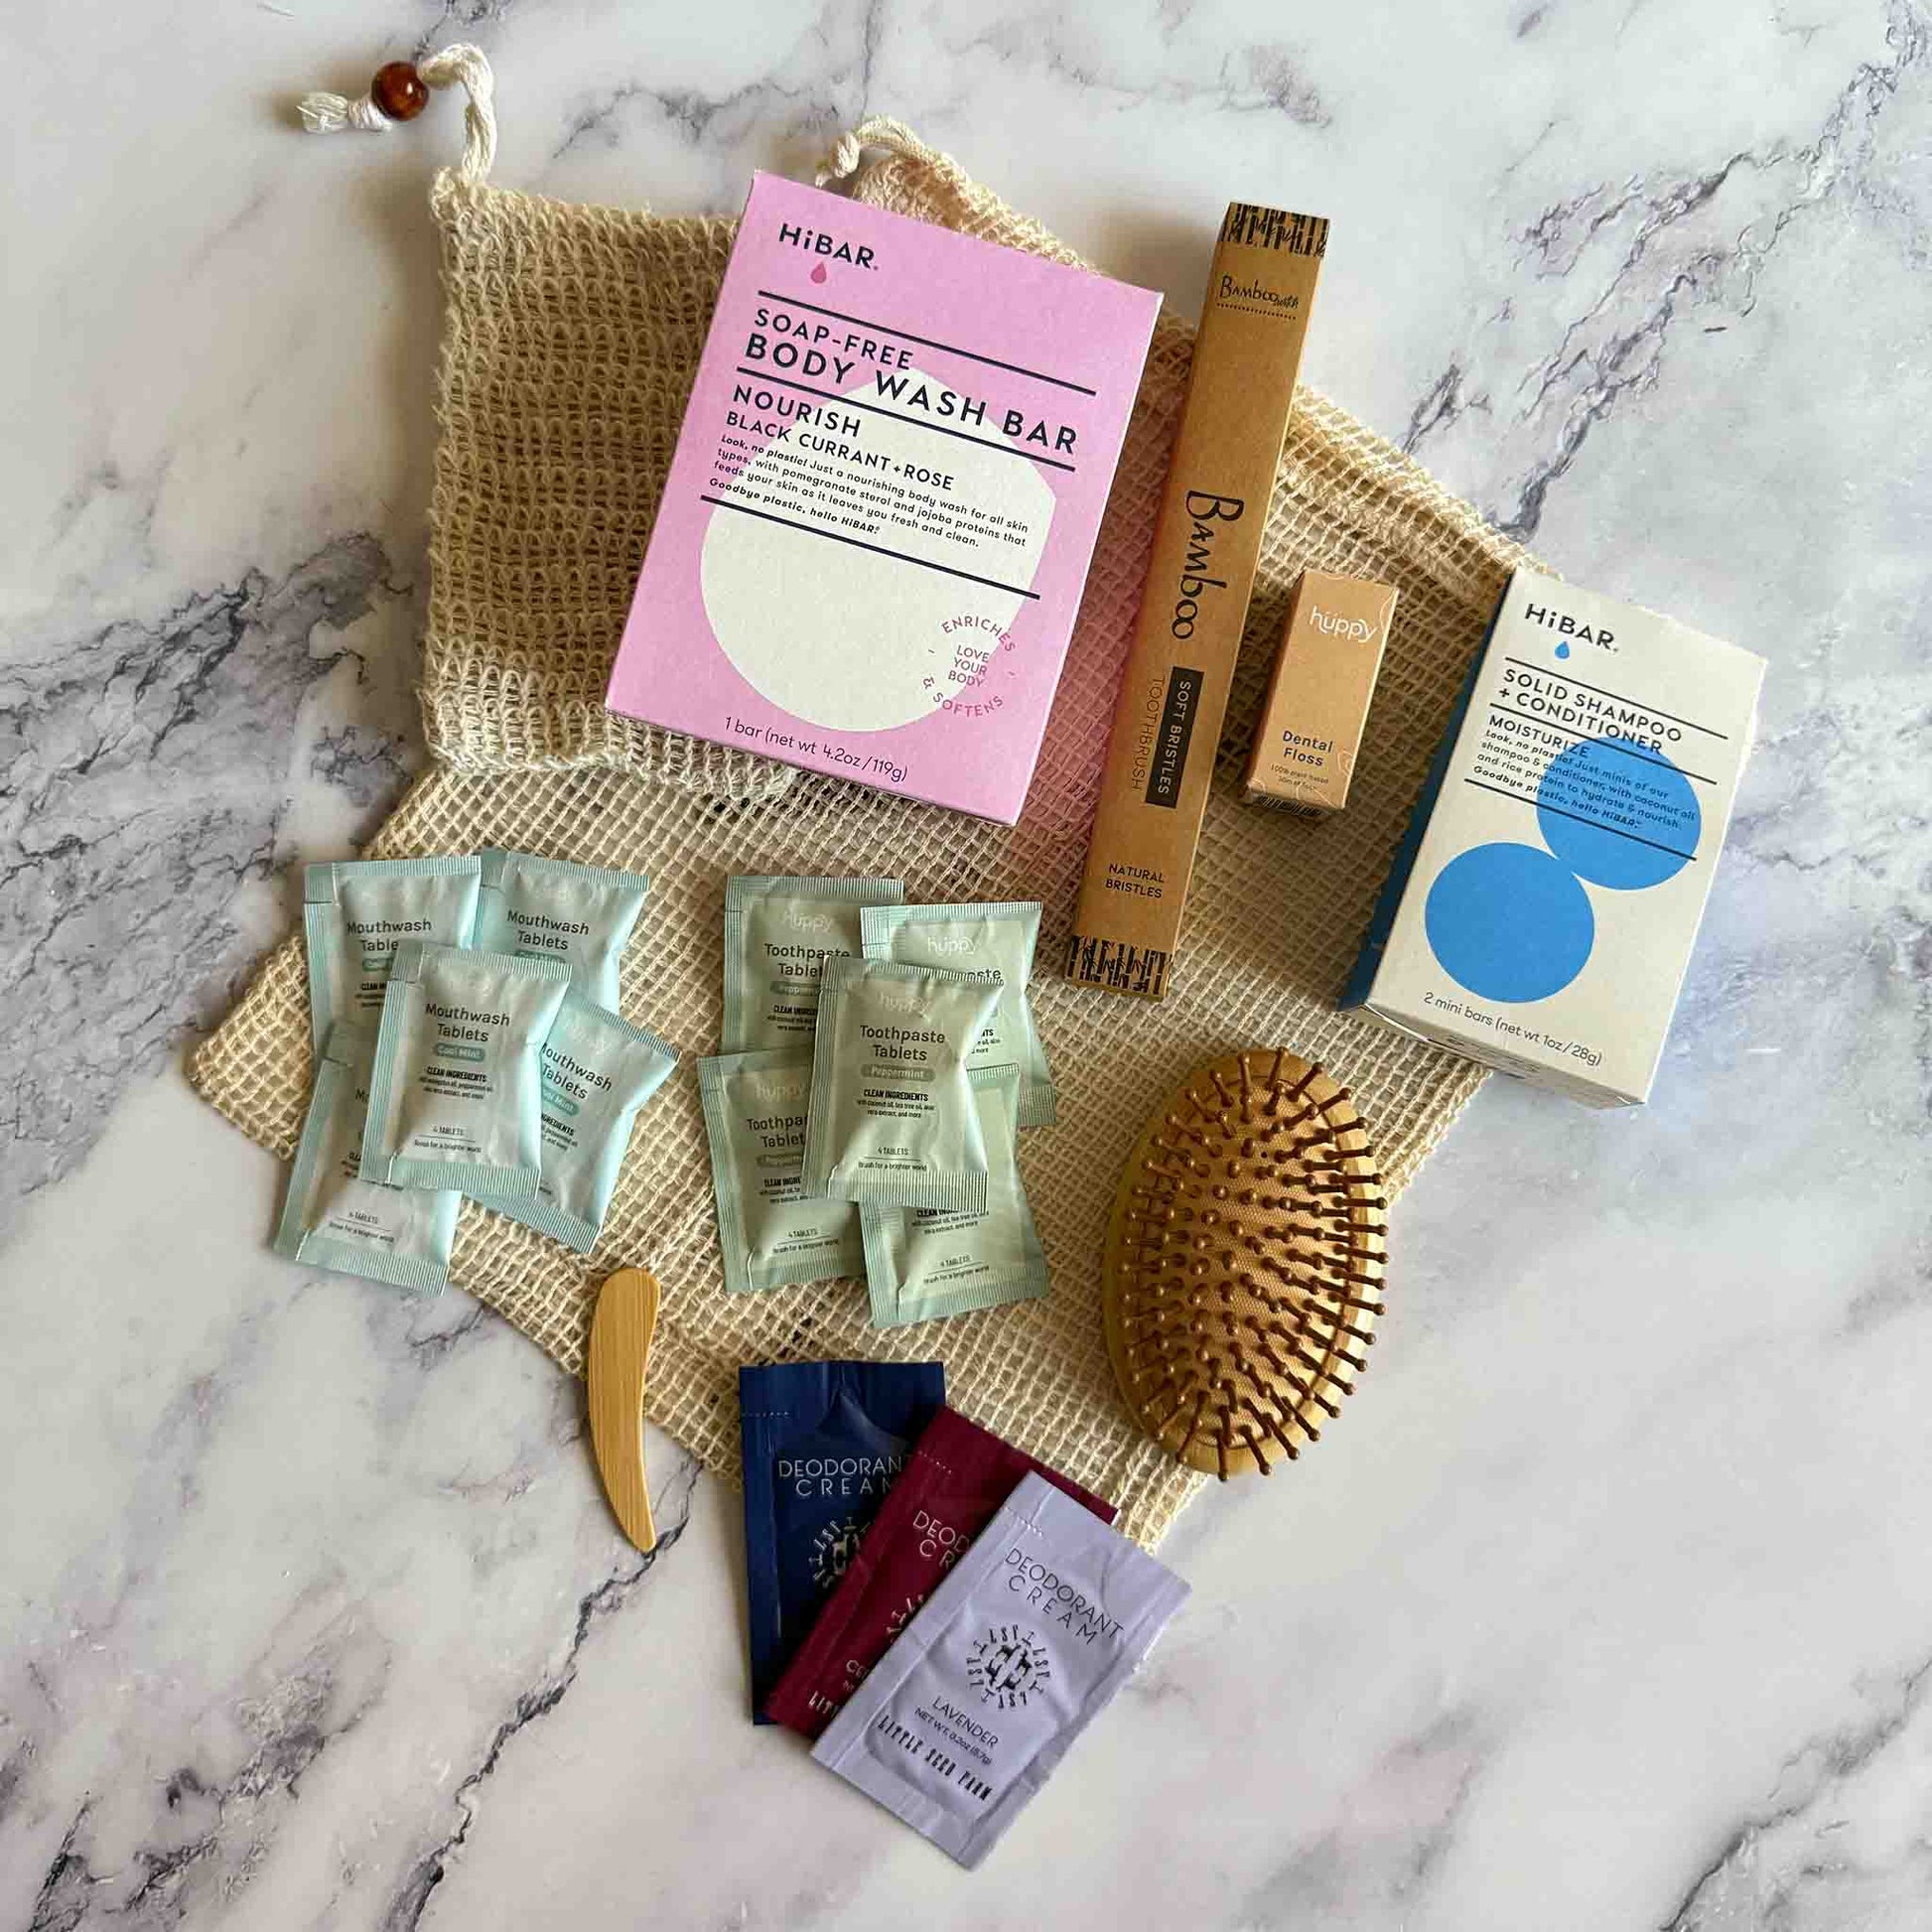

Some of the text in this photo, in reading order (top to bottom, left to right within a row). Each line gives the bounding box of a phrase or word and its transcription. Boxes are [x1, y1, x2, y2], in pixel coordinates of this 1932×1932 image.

[754, 308, 913, 370] SOAP-FREE
[733, 384, 861, 438] NOURISH
[745, 333, 1077, 455] BODY WASH BAR
[726, 410, 954, 491] BLACK CURRANT ROSE
[709, 478, 838, 522] Goodbye plastic, hello
[718, 448, 1026, 547] types, with pomegranate sterol and jojoba proteins that
[721, 435, 749, 451] Look,
[751, 445, 764, 454] no
[765, 450, 808, 467] plastic!
[809, 460, 833, 476] Just
[847, 473, 905, 498] nourishing
[907, 489, 936, 507] body
[939, 500, 967, 514] wash
[971, 507, 987, 520] for
[989, 515, 1004, 525] all
[1006, 520, 1029, 533] skin
[714, 460, 979, 547] feeds your skin as it leaves you fresh and clean.
[941, 616, 1016, 652] ENRICHES
[953, 657, 988, 676] YOUR
[957, 644, 990, 663] LOVE
[948, 670, 984, 687] BODY
[933, 692, 1004, 718] SOFTENS
[1499, 688, 1663, 756] + CONDITIONER
[1503, 668, 1682, 742] SOLID SHAMPOO
[734, 719, 763, 739] bar
[764, 727, 794, 749] (net
[798, 741, 816, 755] wt
[1131, 678, 1165, 792] TOOTHBRUSH
[1158, 680, 1191, 795] SOFT BRISTLES
[1283, 730, 1333, 753] Dental
[1489, 714, 1589, 758] MOISTURIZE
[1284, 748, 1324, 767] Floss
[1105, 880, 1163, 898] BRISTLES
[1109, 863, 1166, 884] NATURAL
[347, 918, 432, 934] Mouthwash
[507, 909, 590, 935] Mouthwash
[362, 938, 399, 951] Table
[517, 930, 569, 951] Tablets
[425, 1003, 510, 1028] Mouthwash
[437, 1024, 489, 1042] Tablets
[1423, 991, 1540, 1042] 2 mini bars (net wt
[860, 1025, 946, 1045] Toothpaste
[873, 1044, 928, 1061] Tablets
[863, 1088, 929, 1102] CLEAN INGREDIENTS
[1005, 1548, 1124, 1639] DEODORANT
[1008, 1574, 1100, 1645] CREAM
[914, 1707, 935, 1724] NET
[932, 1698, 999, 1748] LAVENDER
[878, 1715, 993, 1801] LITTLE SEED FARM
